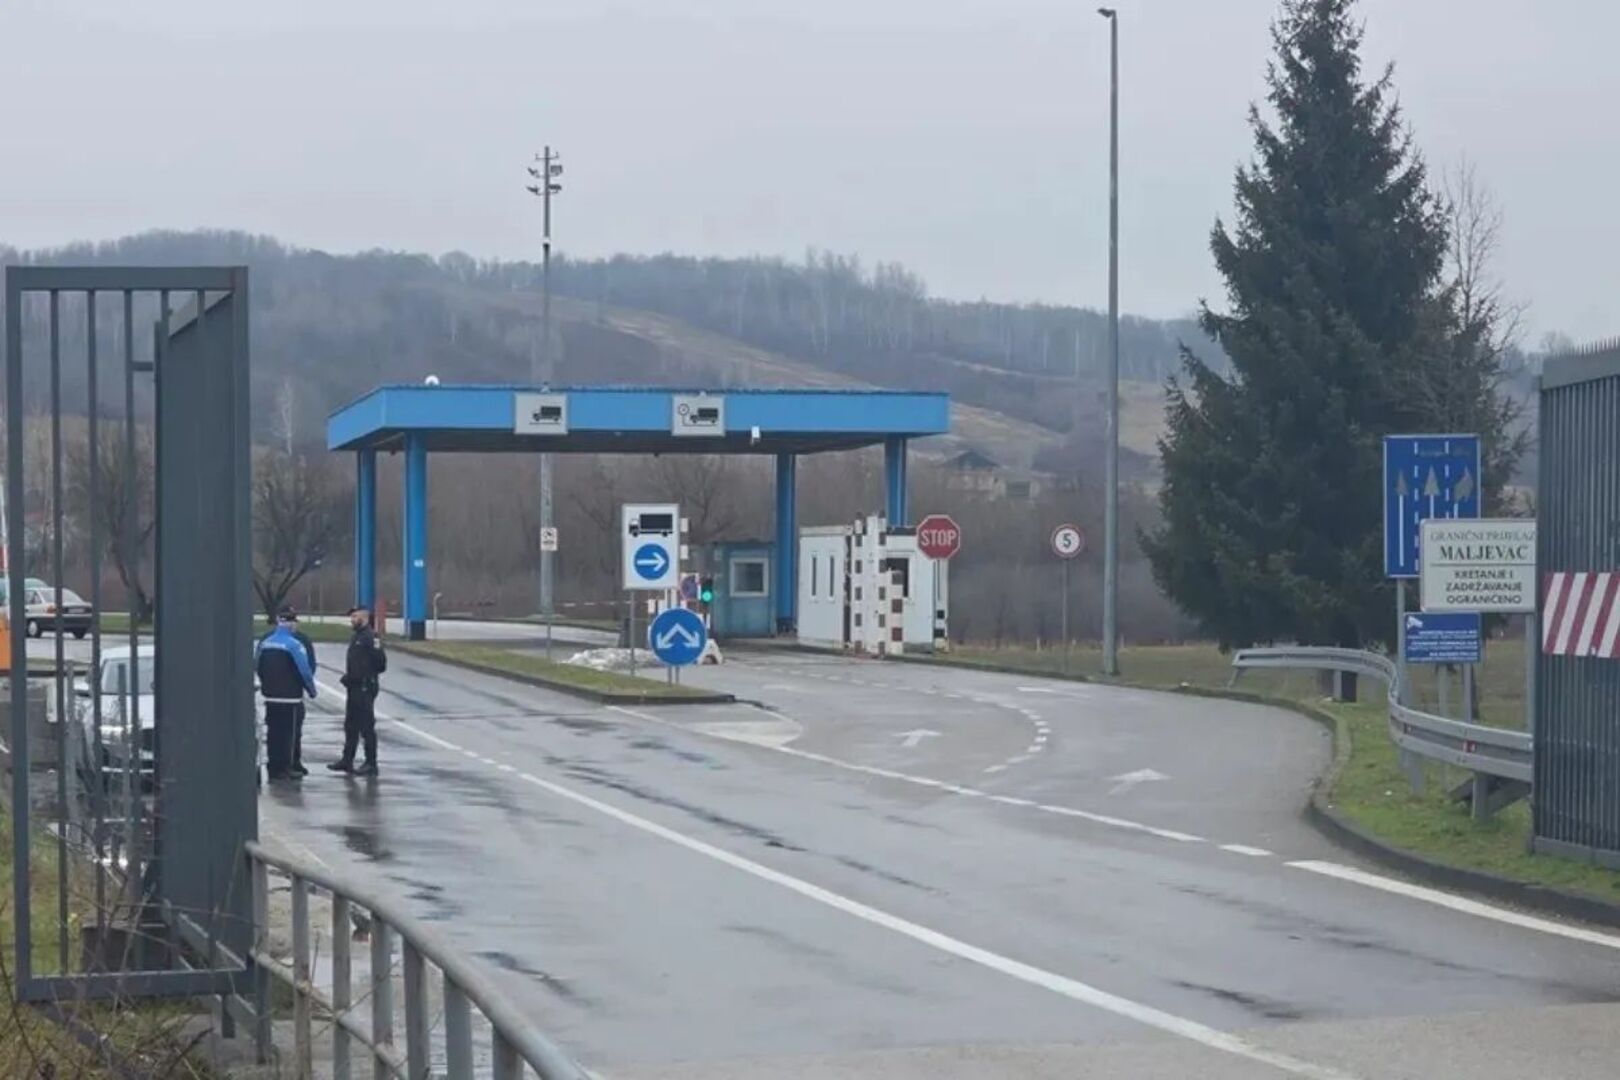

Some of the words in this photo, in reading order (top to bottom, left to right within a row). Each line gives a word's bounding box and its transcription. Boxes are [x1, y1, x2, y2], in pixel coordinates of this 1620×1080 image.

[920, 529, 957, 547] STOP
[1062, 534, 1072, 548] 5
[1440, 545, 1529, 560] MALJEVAC
[1454, 569, 1506, 579] KRETANJE
[1509, 570, 1514, 579] I
